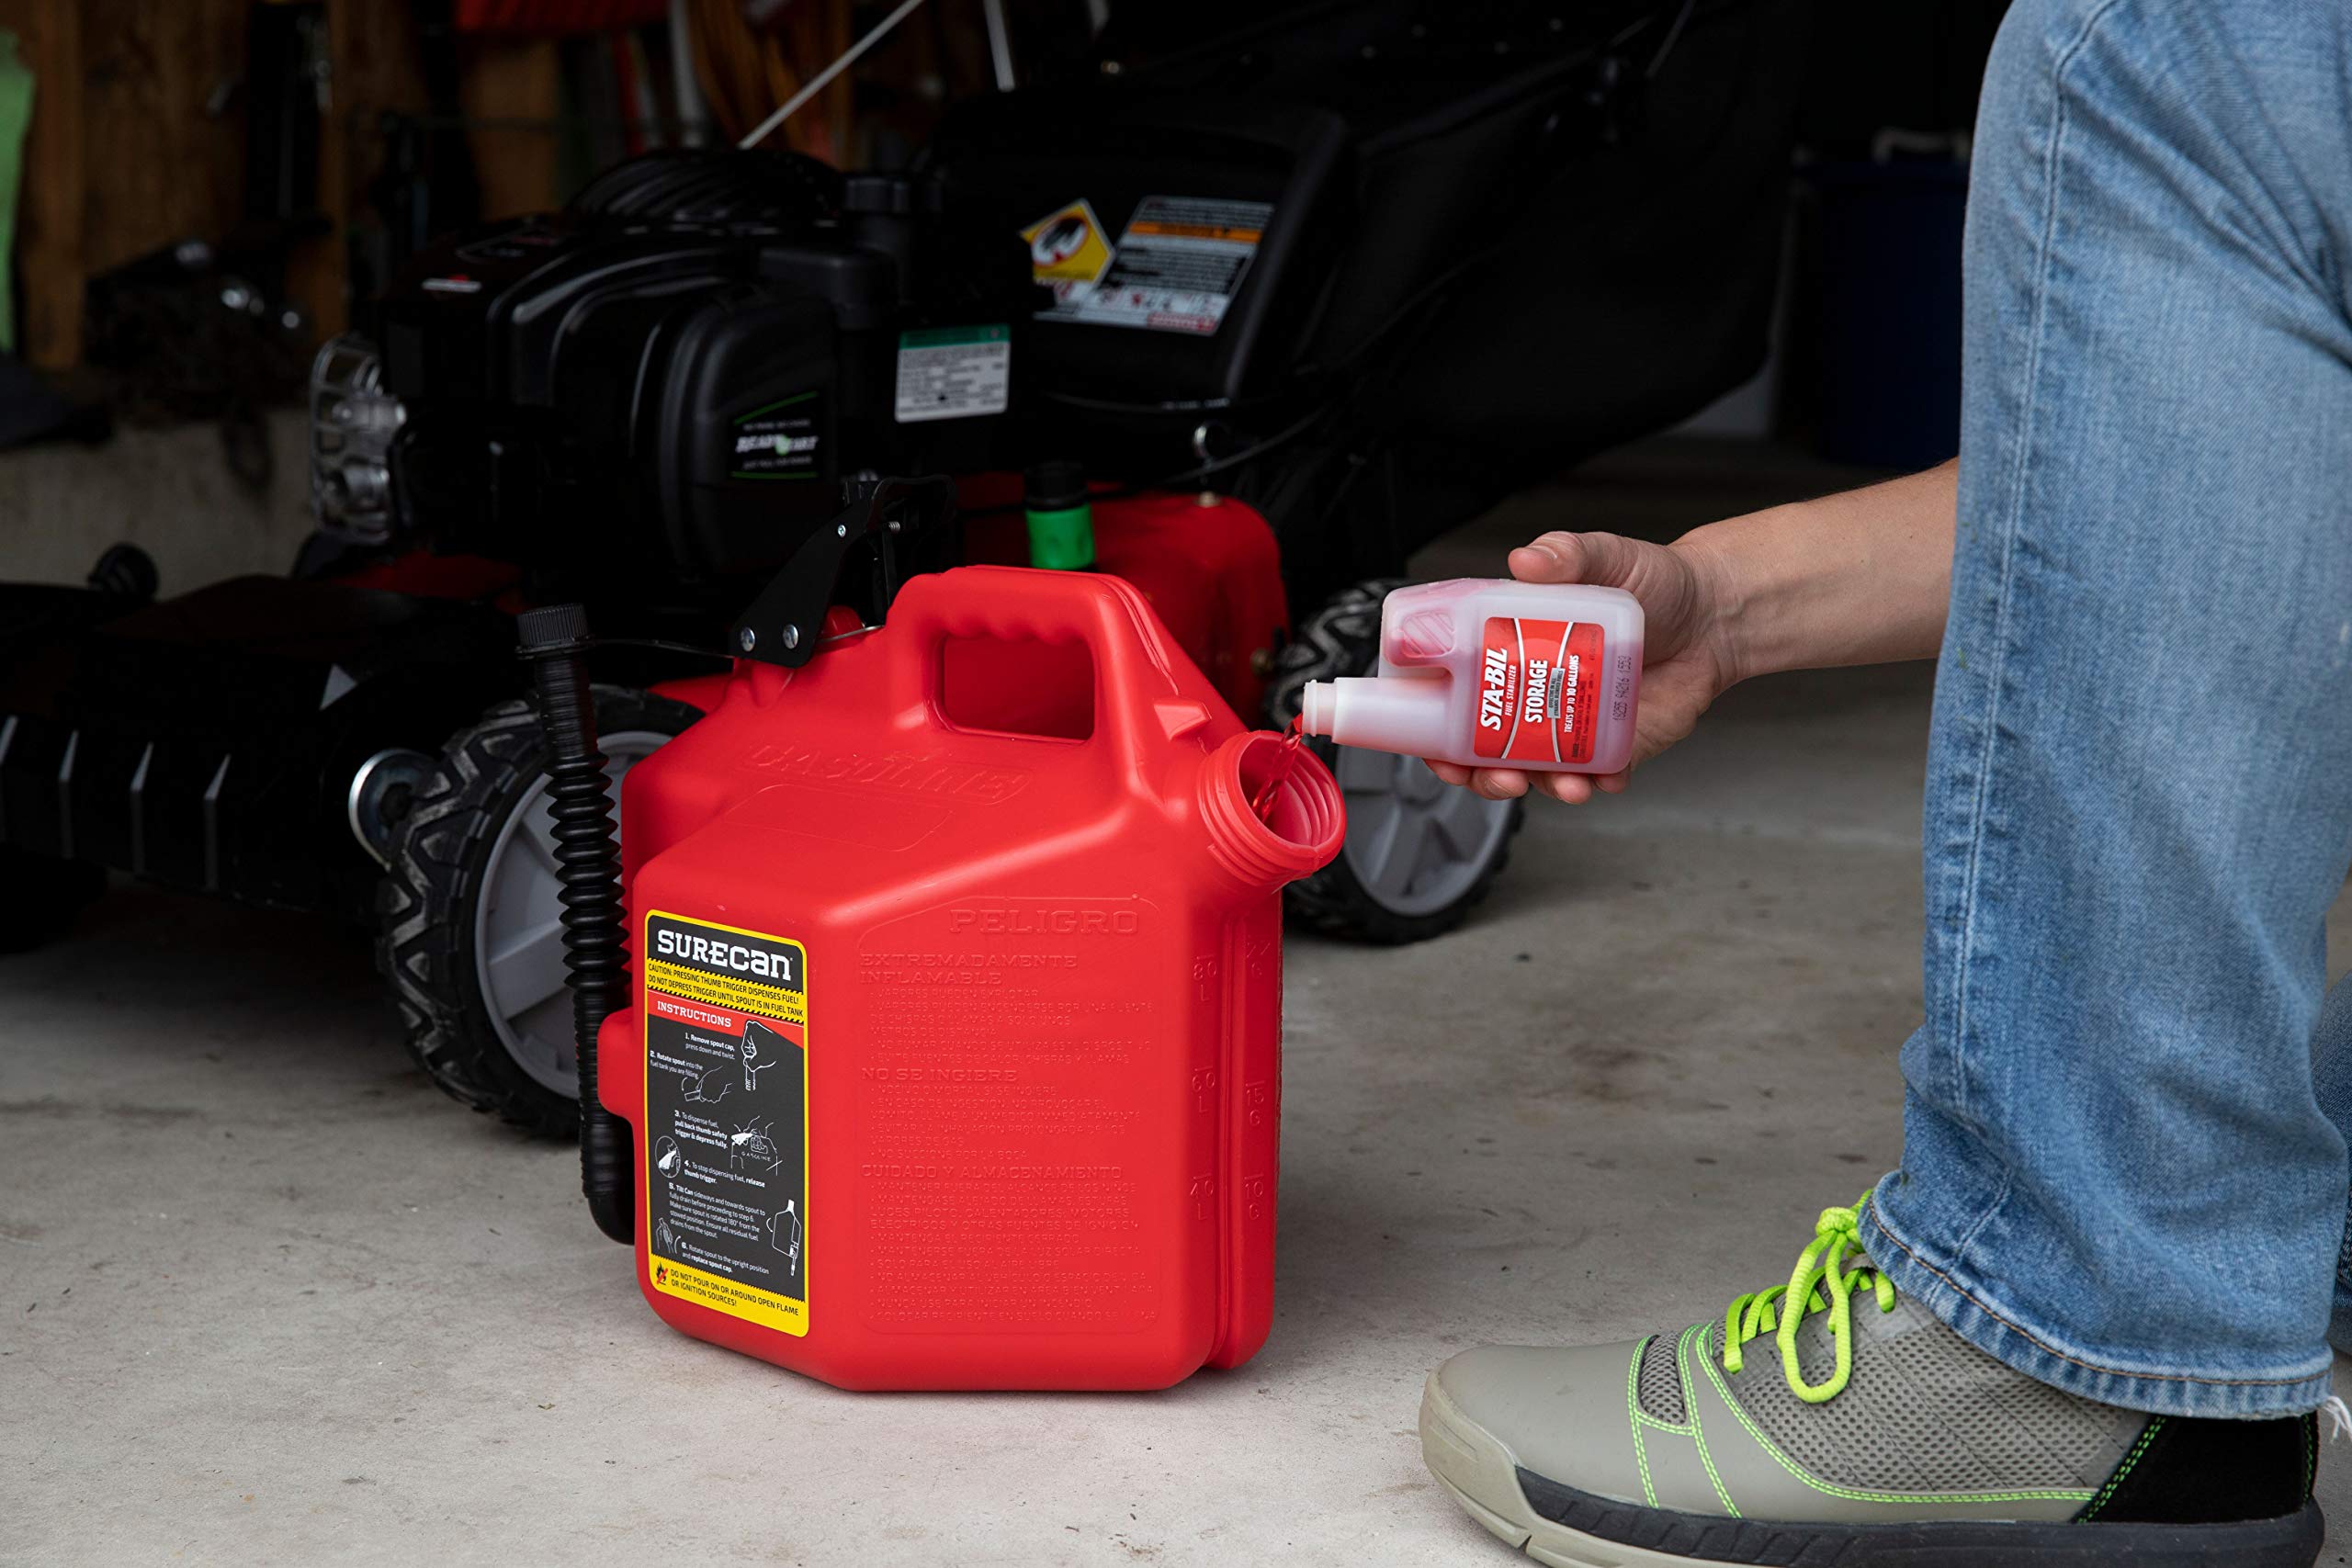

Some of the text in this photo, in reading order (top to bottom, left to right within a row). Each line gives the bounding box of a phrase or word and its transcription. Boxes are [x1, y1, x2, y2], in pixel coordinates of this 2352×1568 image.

[1568, 655, 1578, 687] GALLONS
[1480, 648, 1507, 730] STA-BIL
[1505, 665, 1517, 716] FUEL STABILIZER
[1524, 660, 1548, 722] STORAGE
[1564, 715, 1574, 732] TREATS
[948, 909, 1139, 934] PELIGRO
[649, 964, 798, 1004] CAUTION: PRESSING THUMB TRIGGER DISPENSES FUEL!
[860, 971, 1002, 986] INFLAMABLE
[649, 975, 655, 983] DO
[669, 979, 692, 992] DEPRESS
[693, 986, 717, 997] TRIGGER
[718, 992, 734, 1002] UNTIL
[736, 996, 755, 1006] SPOUT
[771, 1003, 786, 1013] FUEL
[658, 1001, 731, 1027] INSTRUCTIONS
[691, 1034, 709, 1044] Remove
[710, 1040, 725, 1048] spout
[697, 1045, 712, 1054] down
[650, 1050, 656, 1058] 2.
[657, 1052, 672, 1063] Rotate
[672, 1058, 685, 1066] spout
[650, 1059, 659, 1067] fuel
[861, 1067, 1018, 1082] NO SE INGIERE
[674, 1110, 681, 1118] 3.
[682, 1111, 688, 1120] To
[687, 1114, 707, 1125] dispense
[674, 1128, 692, 1138] trigger
[695, 1134, 715, 1145] depress
[684, 1122, 695, 1131] back
[695, 1125, 712, 1135] thumb
[711, 1131, 728, 1141] safety
[684, 1159, 691, 1168] 4.
[698, 1165, 708, 1173] stop
[708, 1168, 734, 1181] dispensing
[746, 1178, 765, 1188] release
[684, 1169, 700, 1179] thumb
[861, 1164, 1123, 1180] CUIDADO Y ALMACENAMIENTO
[669, 1191, 679, 1201] fully
[679, 1195, 691, 1203] drain
[691, 1199, 707, 1209] before
[707, 1204, 732, 1217] proceeding
[738, 1213, 750, 1222] step
[684, 1187, 694, 1196] Can
[694, 1191, 715, 1202] sideways
[724, 1200, 744, 1211] towards
[744, 1206, 759, 1214] spout
[670, 1200, 683, 1210] Make
[692, 1209, 705, 1217] spout
[710, 1214, 728, 1224] rotated
[739, 1221, 751, 1230] from
[670, 1210, 686, 1220] stowed
[706, 1220, 722, 1231] Ensure
[729, 1228, 748, 1238] residual
[670, 1218, 684, 1227] drains
[684, 1222, 695, 1231] from
[689, 1244, 704, 1255] Rotate
[704, 1250, 717, 1259] spout
[723, 1256, 731, 1264] the
[730, 1259, 749, 1269] upright
[690, 1255, 708, 1265] replace
[707, 1260, 722, 1269] spout
[671, 1269, 678, 1278] DO
[694, 1277, 708, 1286] POUR
[711, 1282, 719, 1291] ON
[731, 1290, 756, 1303] AROUND
[758, 1297, 775, 1308] OPEN
[777, 1303, 798, 1315] FLAME
[683, 1283, 706, 1296] IGNITION
[708, 1292, 736, 1306] SOURCES!
